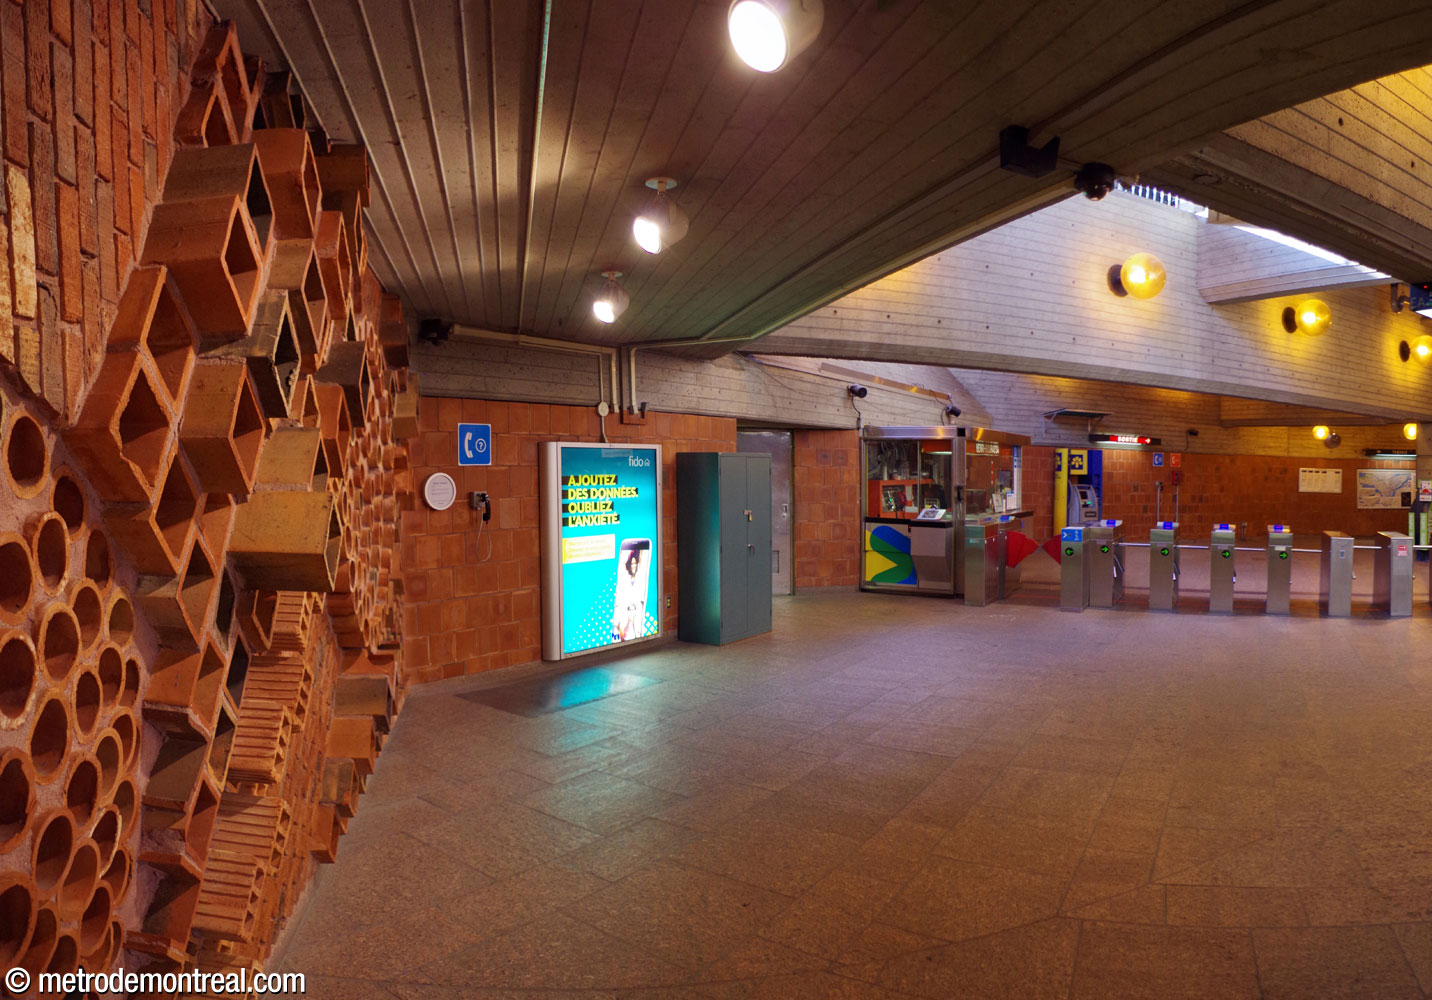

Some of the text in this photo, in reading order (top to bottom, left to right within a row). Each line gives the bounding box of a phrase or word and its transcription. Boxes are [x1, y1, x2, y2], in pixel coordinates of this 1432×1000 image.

[628, 455, 644, 467] fido
[567, 475, 616, 486] AJOUTEZ
[568, 485, 638, 500] DES DONNÉES.
[568, 500, 613, 514] OUBLIEZ
